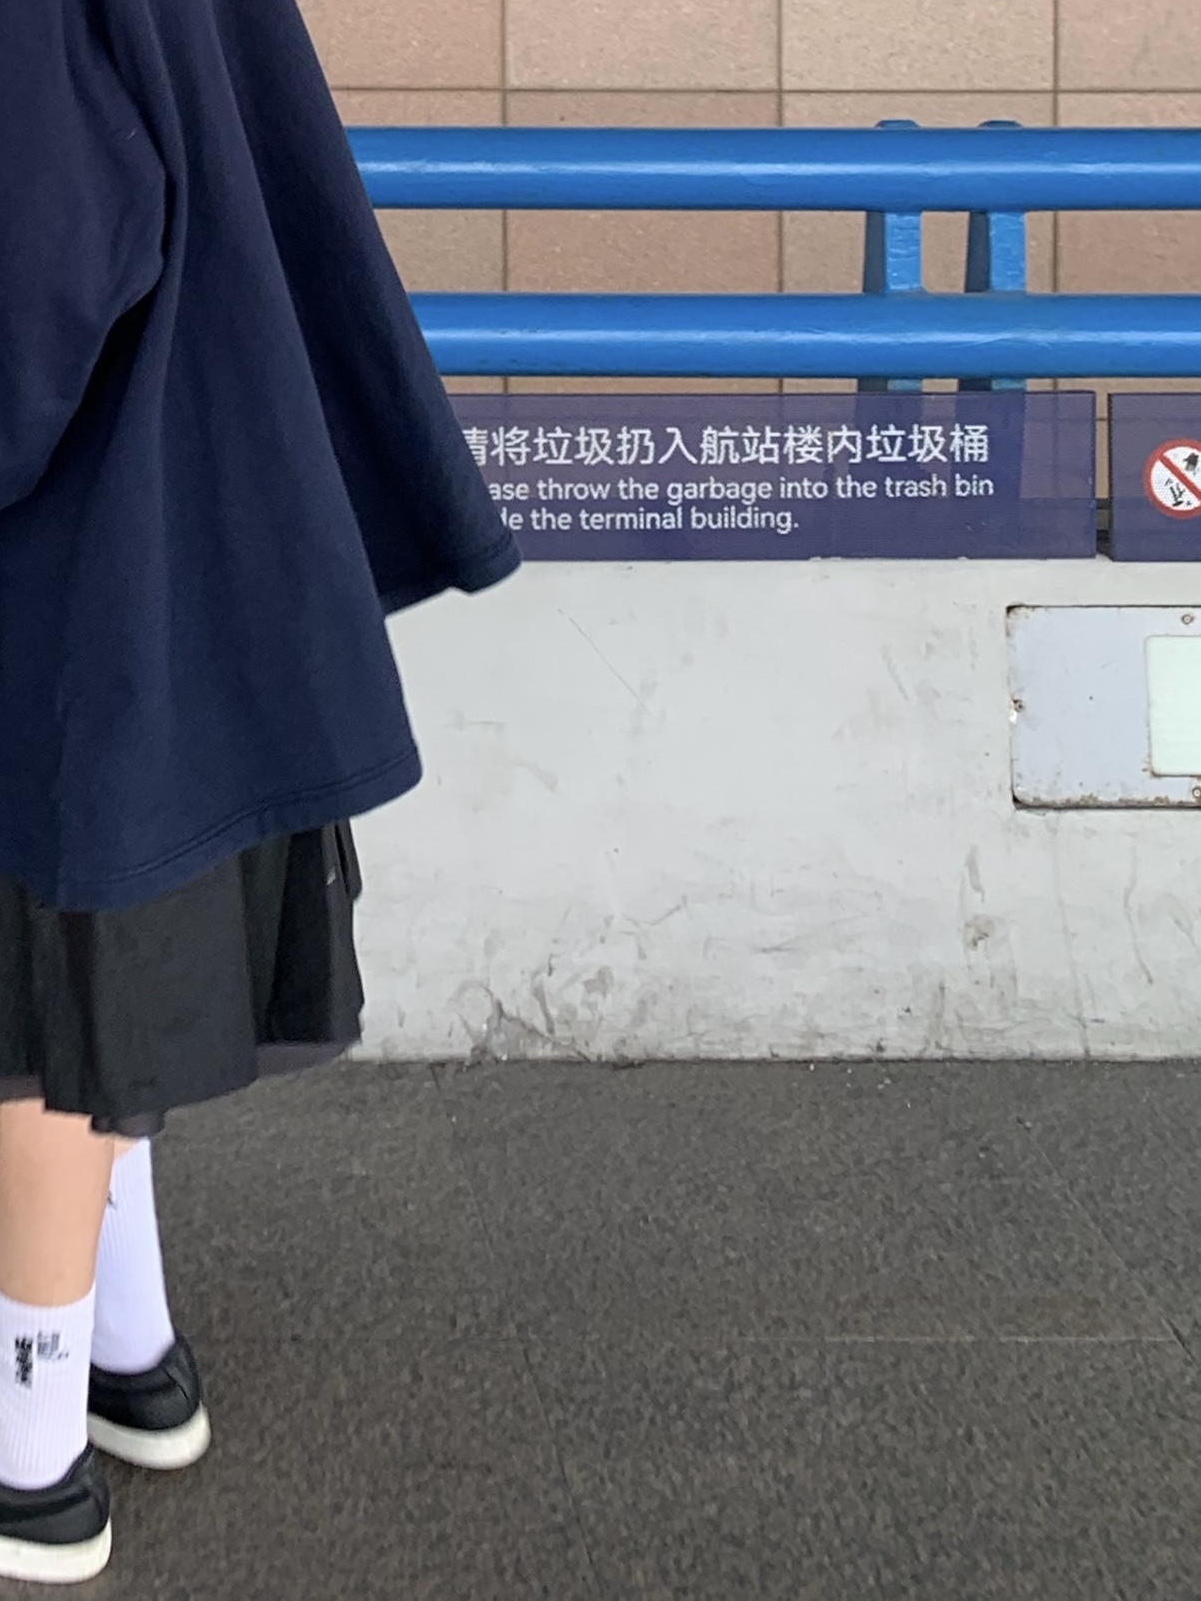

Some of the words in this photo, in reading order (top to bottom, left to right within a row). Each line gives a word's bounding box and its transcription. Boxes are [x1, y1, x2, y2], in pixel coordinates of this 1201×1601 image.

[536, 477, 610, 500] throw
[617, 476, 660, 500] the
[666, 475, 773, 506] garbage
[779, 476, 829, 499] into
[835, 474, 878, 499] the
[884, 473, 948, 498] trash
[954, 472, 995, 497] bin
[529, 506, 573, 530] the
[579, 505, 683, 530] terminal
[690, 504, 800, 535] building.
